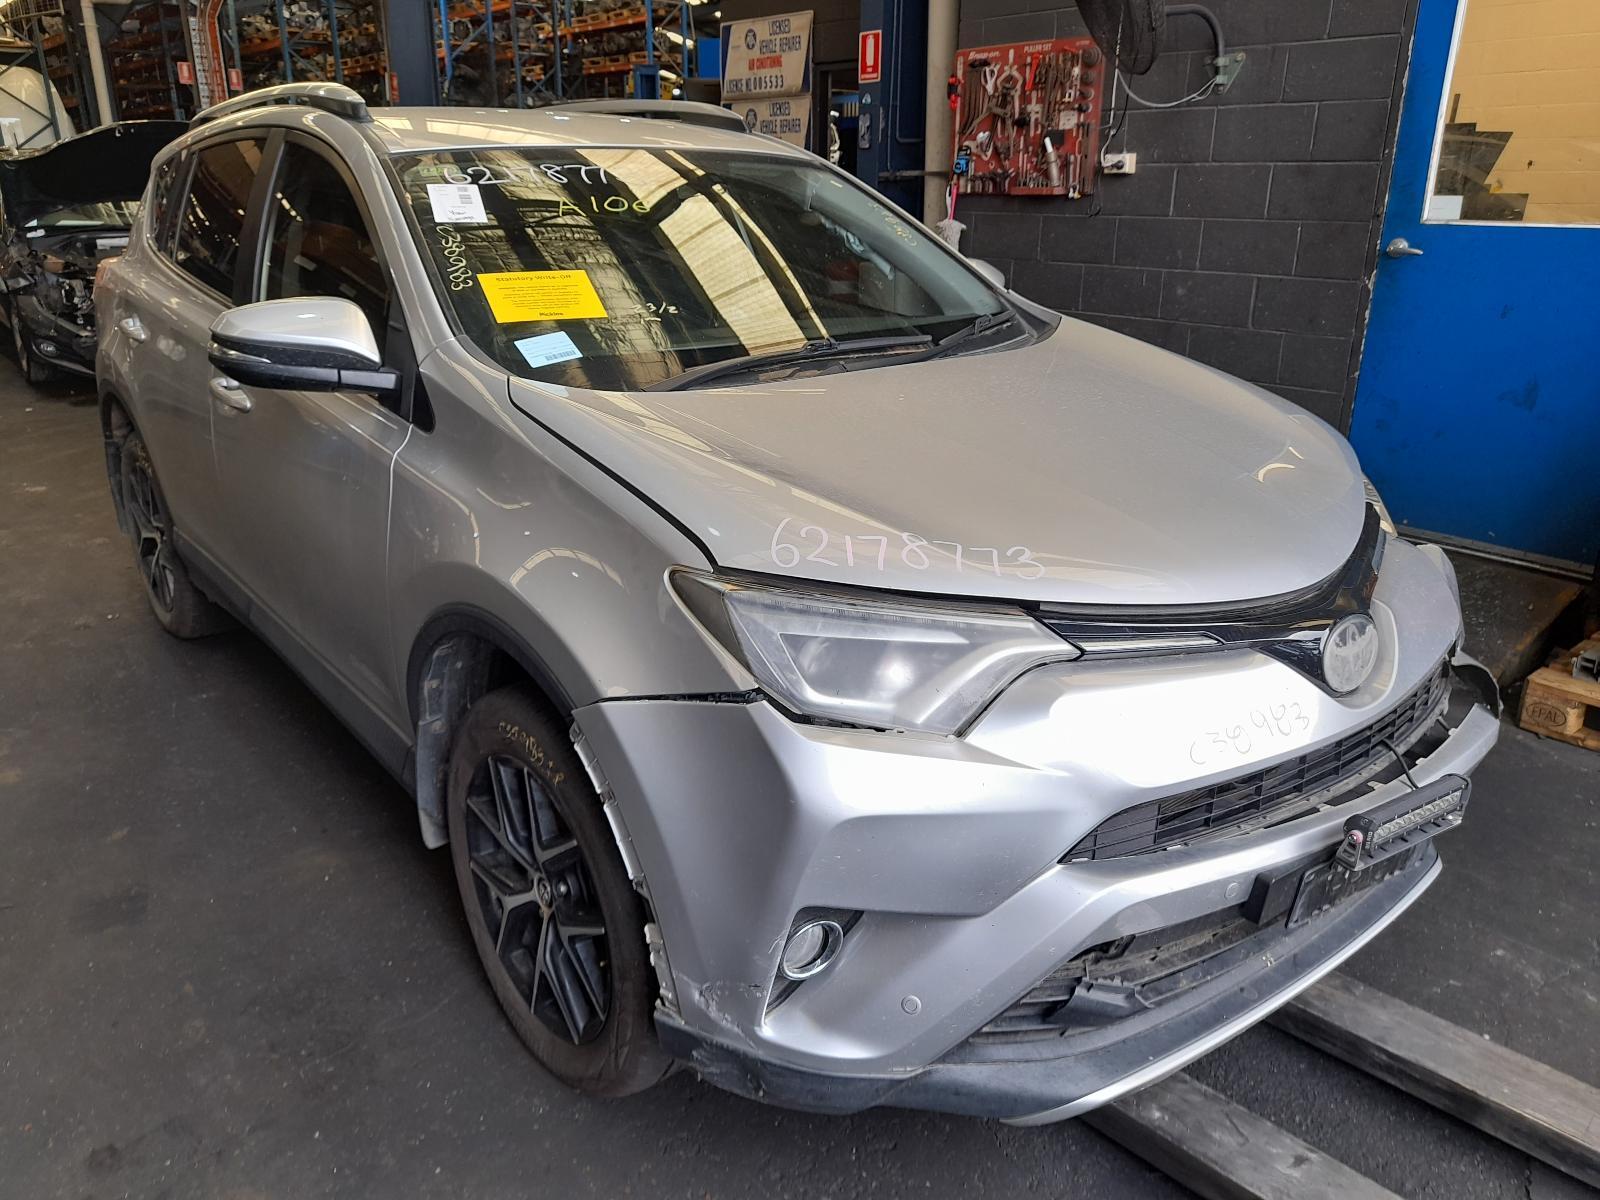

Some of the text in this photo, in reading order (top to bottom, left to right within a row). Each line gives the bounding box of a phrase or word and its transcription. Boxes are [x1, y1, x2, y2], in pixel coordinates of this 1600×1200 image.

[1042, 43, 1052, 51] SET
[769, 517, 1046, 580] 62178773
[1531, 705, 1564, 723] EPAL
